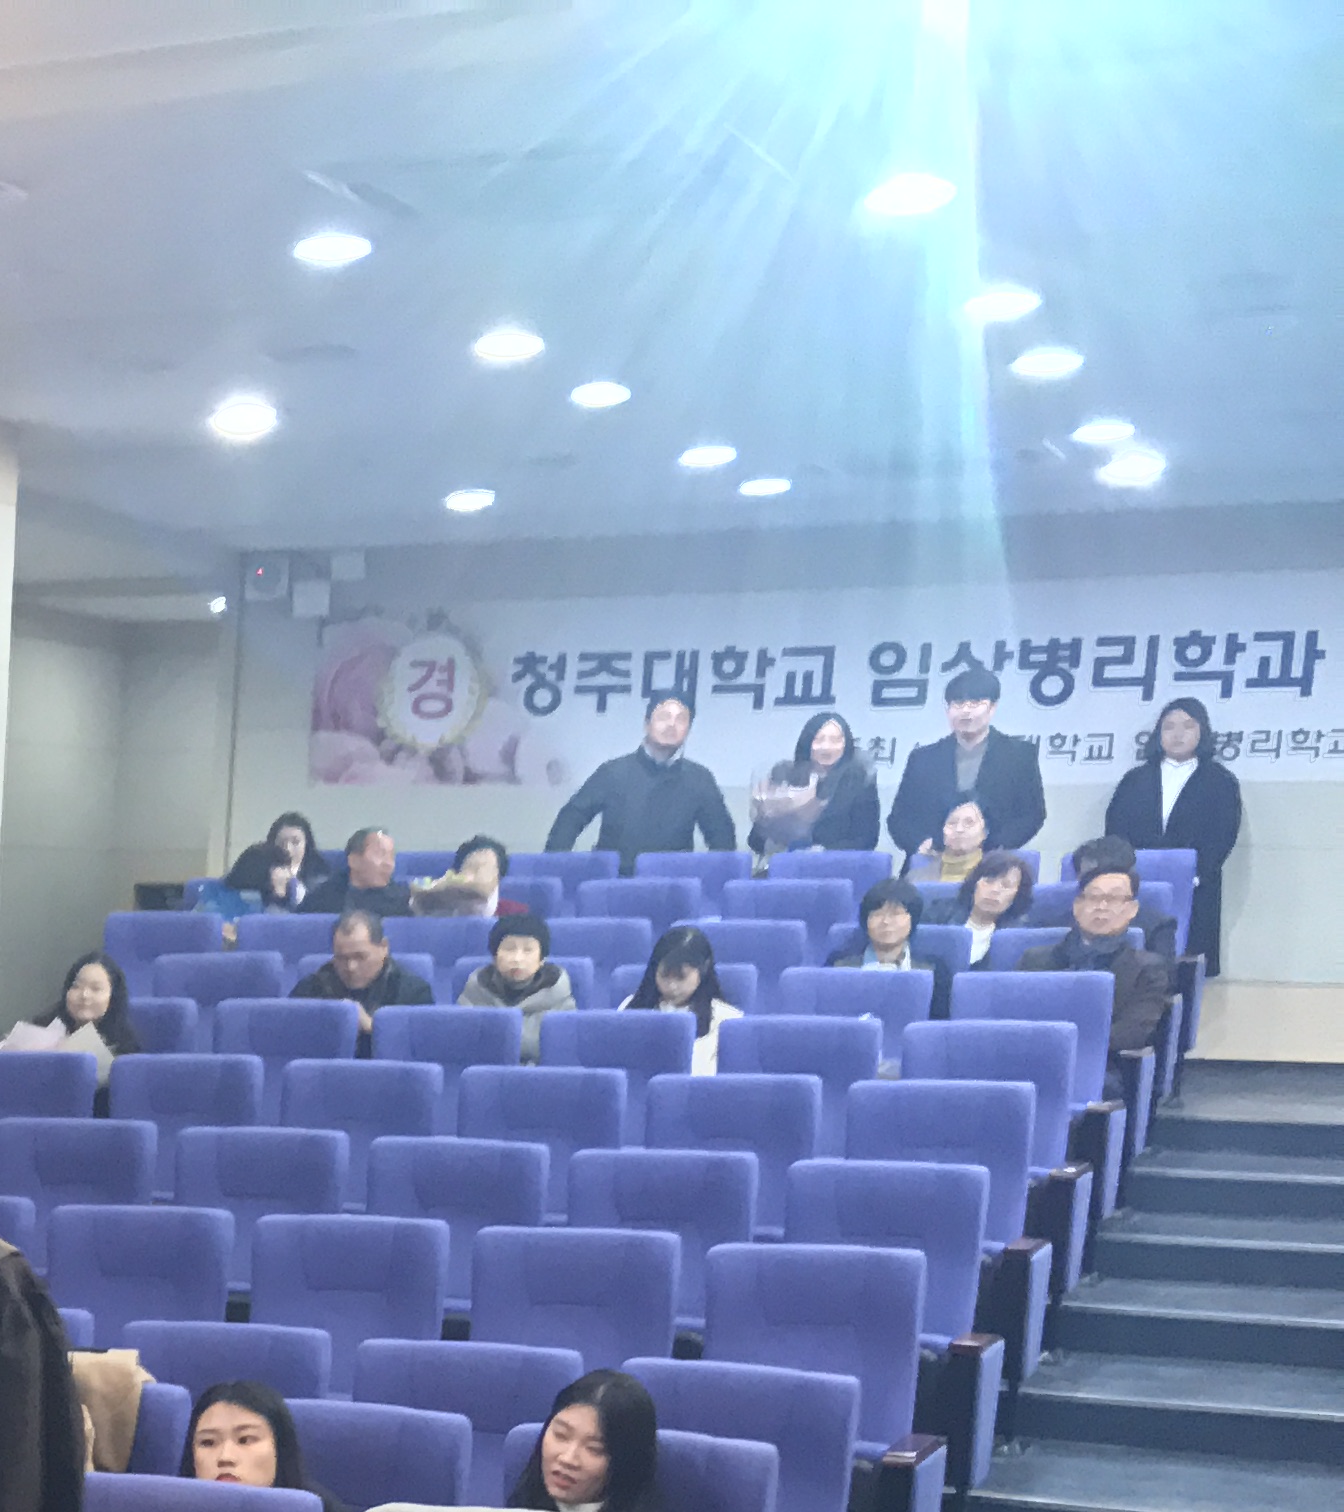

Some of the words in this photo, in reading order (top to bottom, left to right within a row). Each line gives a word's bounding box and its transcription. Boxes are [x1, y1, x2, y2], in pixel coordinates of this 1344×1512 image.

[408, 656, 456, 719] 경
[513, 645, 837, 716] 청주대학교
[869, 629, 1326, 708] 임상병리학과
